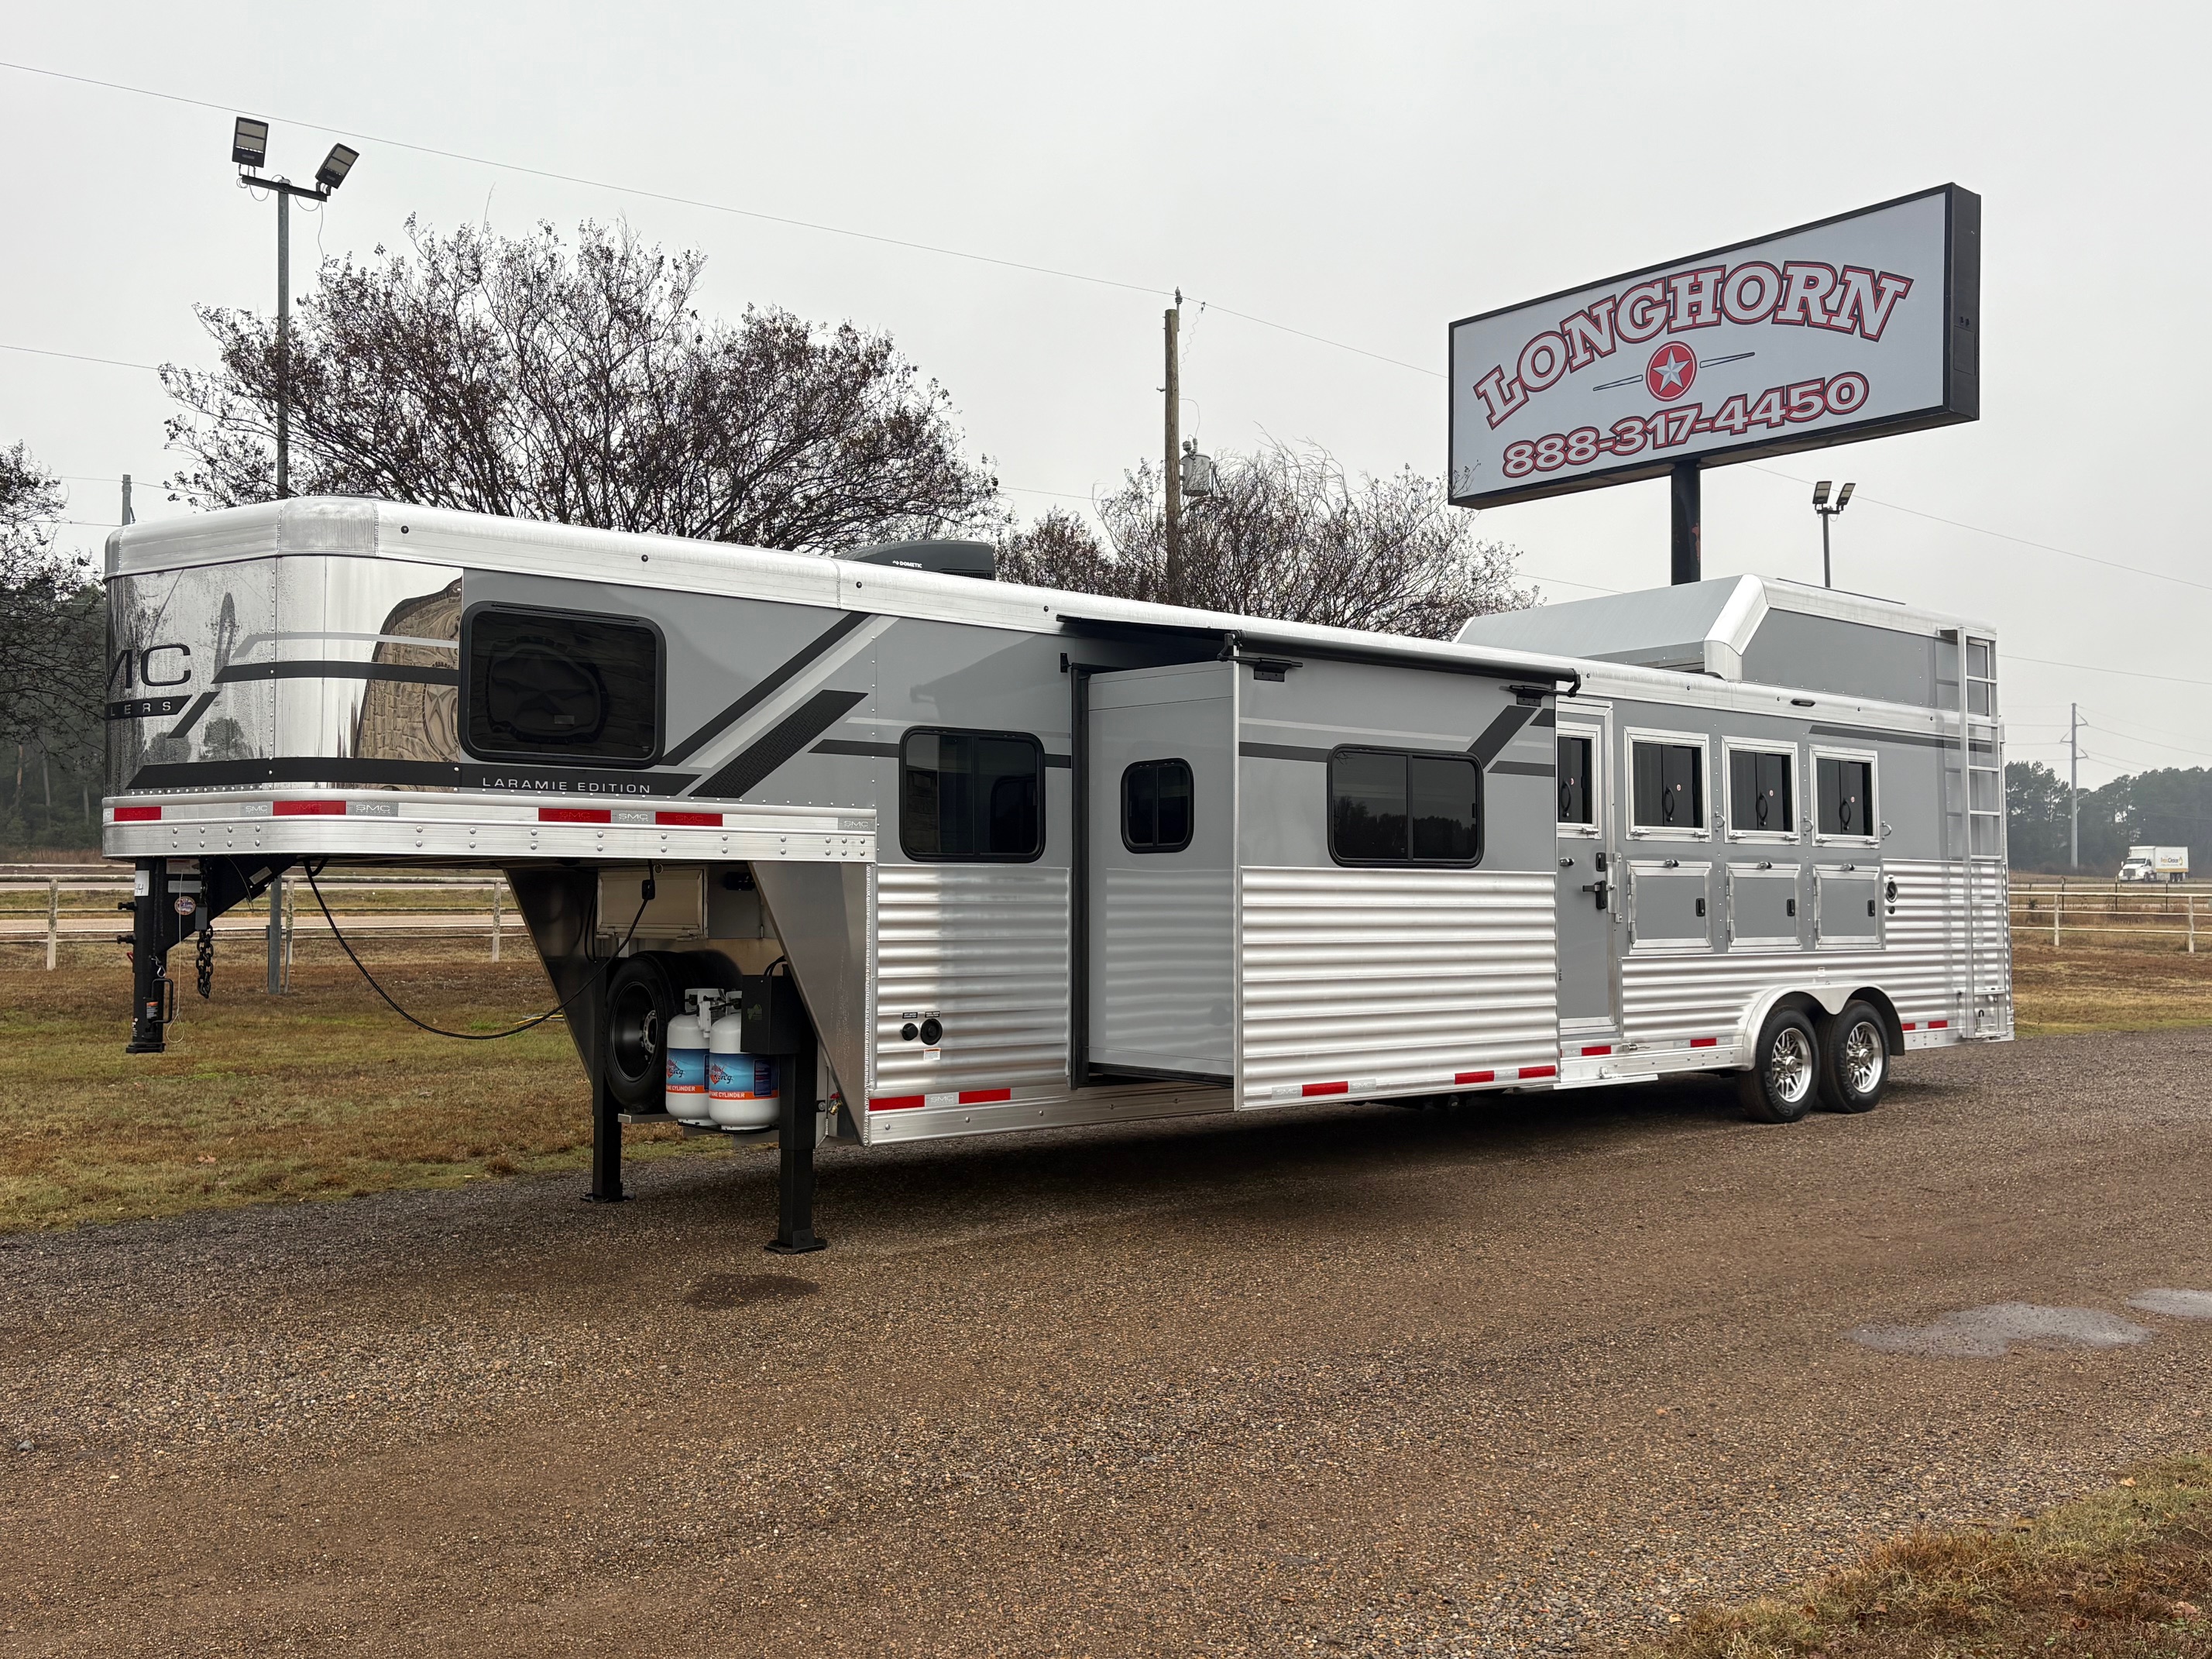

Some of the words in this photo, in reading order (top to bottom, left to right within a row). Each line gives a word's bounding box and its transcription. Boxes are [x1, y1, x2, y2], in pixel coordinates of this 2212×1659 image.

[1473, 261, 1914, 431] LONGHORN
[1503, 372, 1870, 479] 888-317-4450
[483, 778, 568, 791] LARAMIE
[578, 782, 650, 794] EDITION
